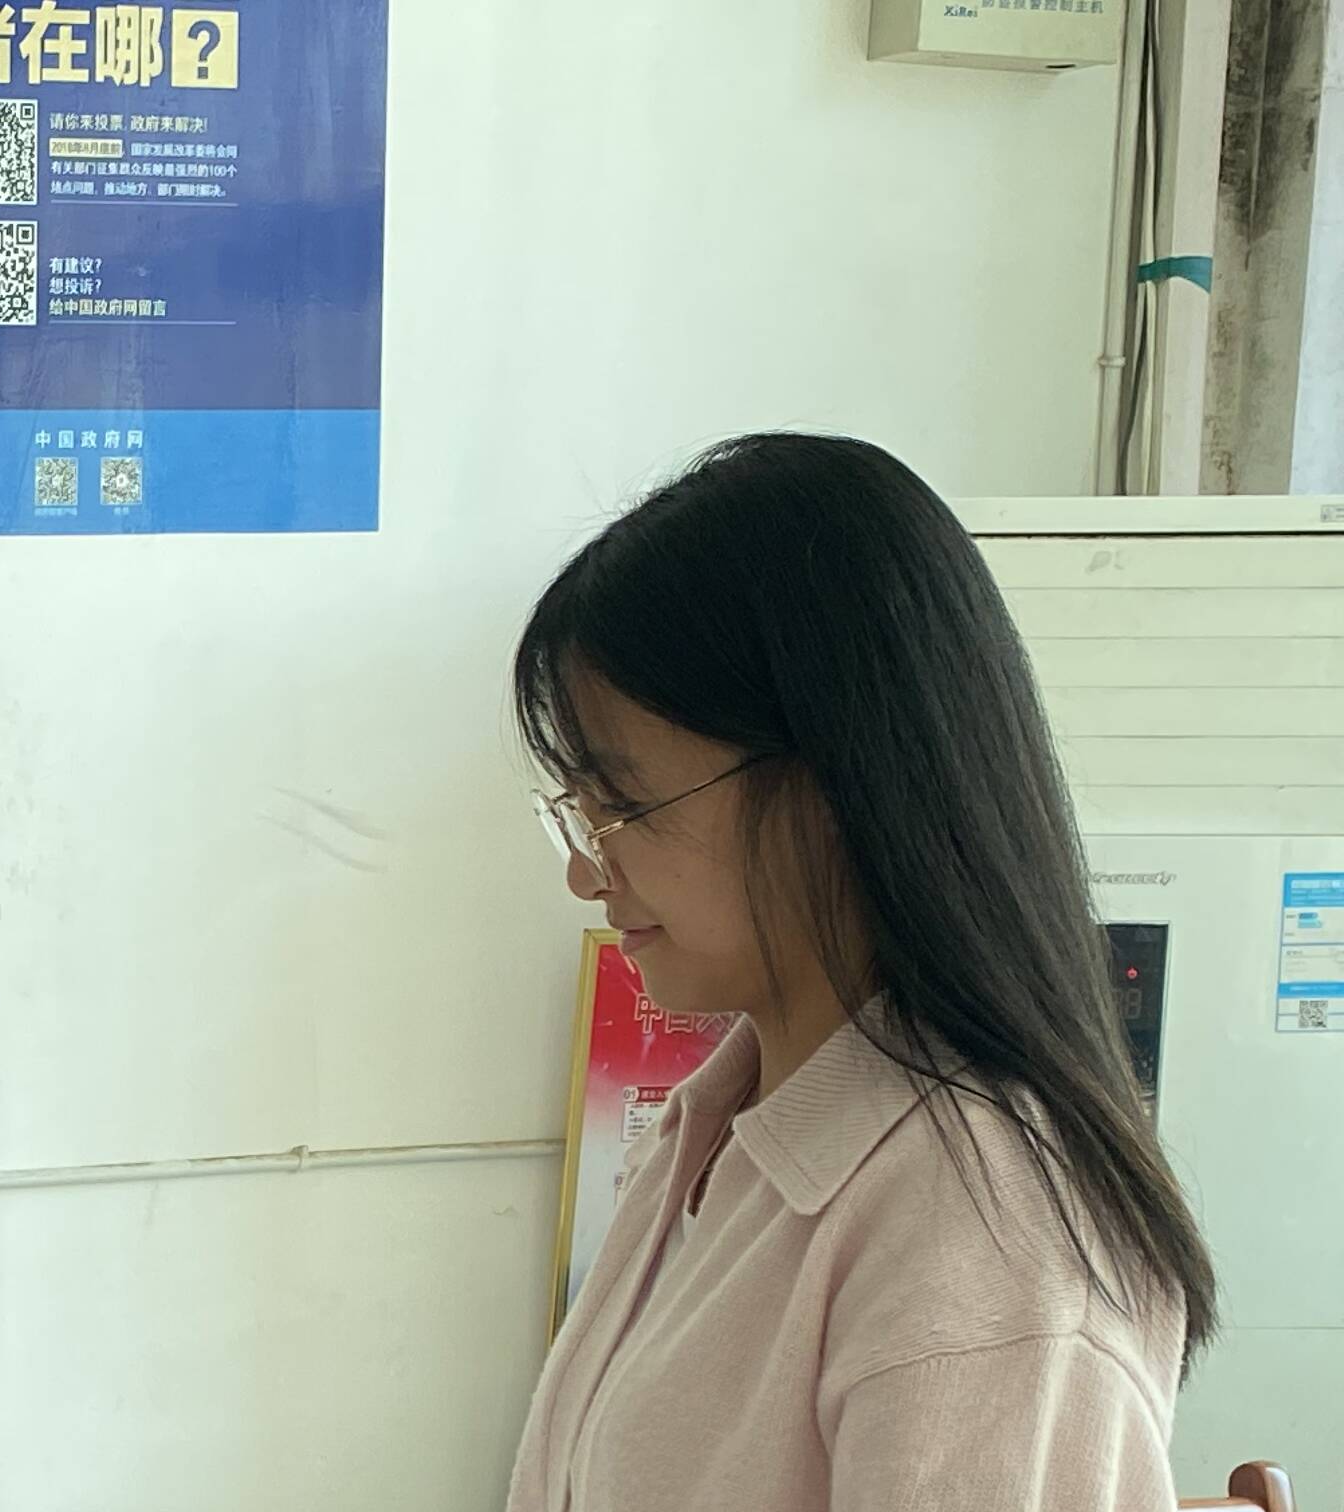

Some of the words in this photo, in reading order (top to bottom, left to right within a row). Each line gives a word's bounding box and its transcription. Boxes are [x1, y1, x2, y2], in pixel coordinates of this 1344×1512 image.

[48, 298, 167, 317] 给中国政府网留言
[34, 429, 144, 449] 中国政府网
